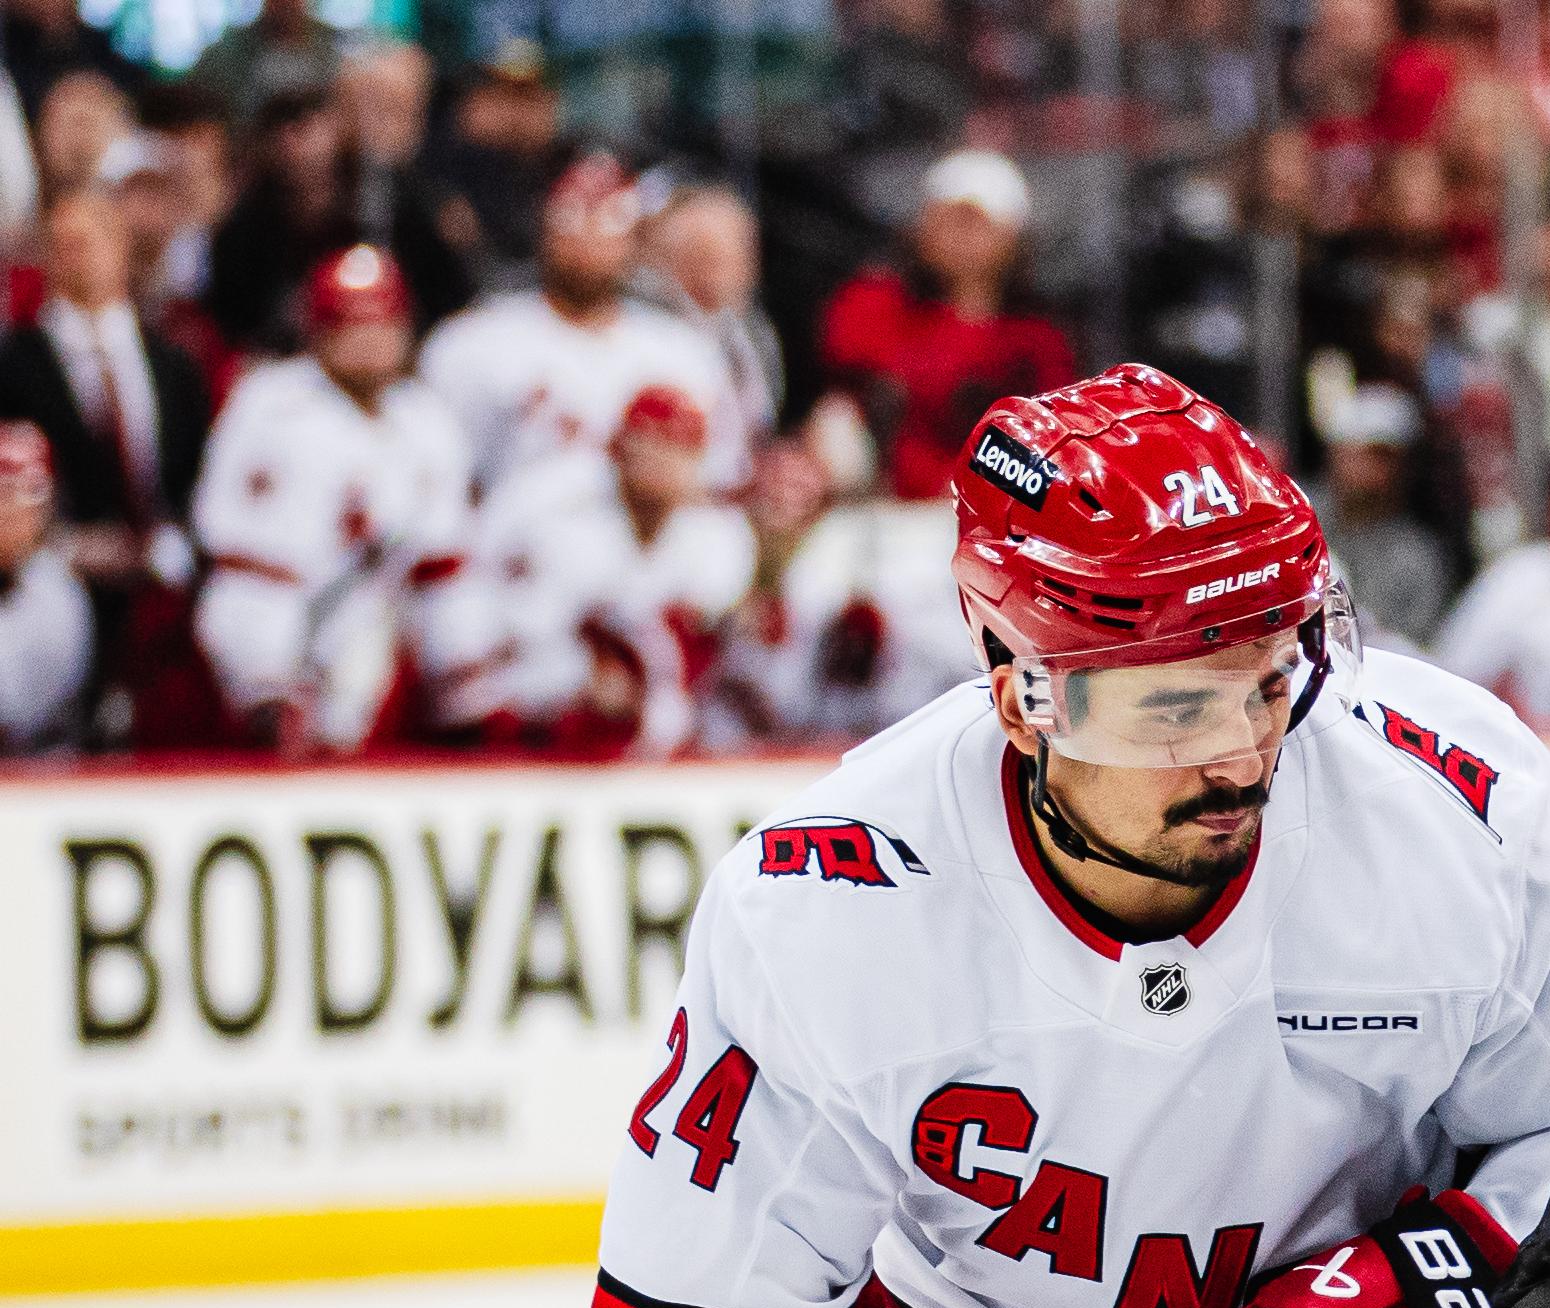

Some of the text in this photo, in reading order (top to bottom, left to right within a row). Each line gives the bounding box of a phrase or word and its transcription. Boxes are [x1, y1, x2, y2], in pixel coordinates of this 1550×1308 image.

[976, 434, 1043, 495] Lenovo
[1163, 465, 1242, 528] 24
[62, 822, 762, 1046] BODYAR
[628, 1006, 760, 1193] 24
